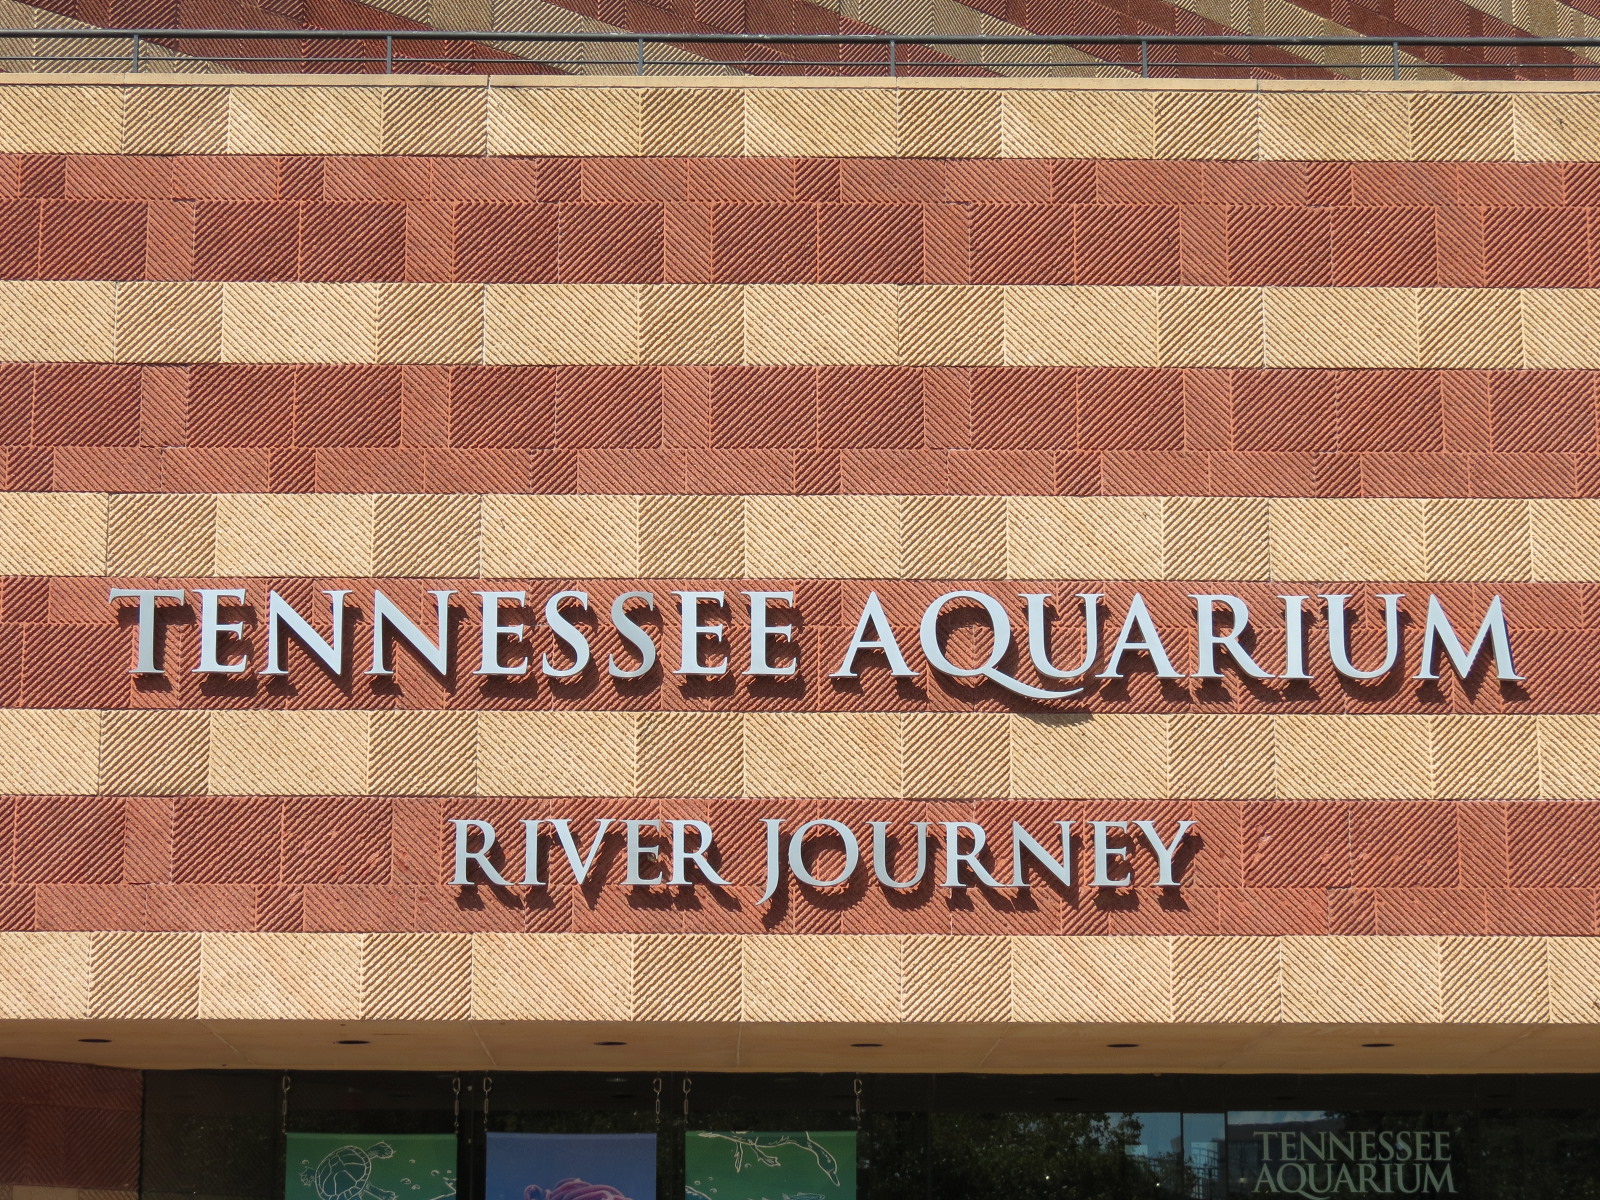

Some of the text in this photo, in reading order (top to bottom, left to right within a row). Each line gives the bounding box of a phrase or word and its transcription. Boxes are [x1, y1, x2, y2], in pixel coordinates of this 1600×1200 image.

[108, 587, 1524, 701] TENNESSEE AQUARIUM
[450, 818, 1198, 907] RIVER JOURNEY
[1254, 1131, 1451, 1160] TENNESSEE
[1253, 1162, 1457, 1200] AQUARIUM
